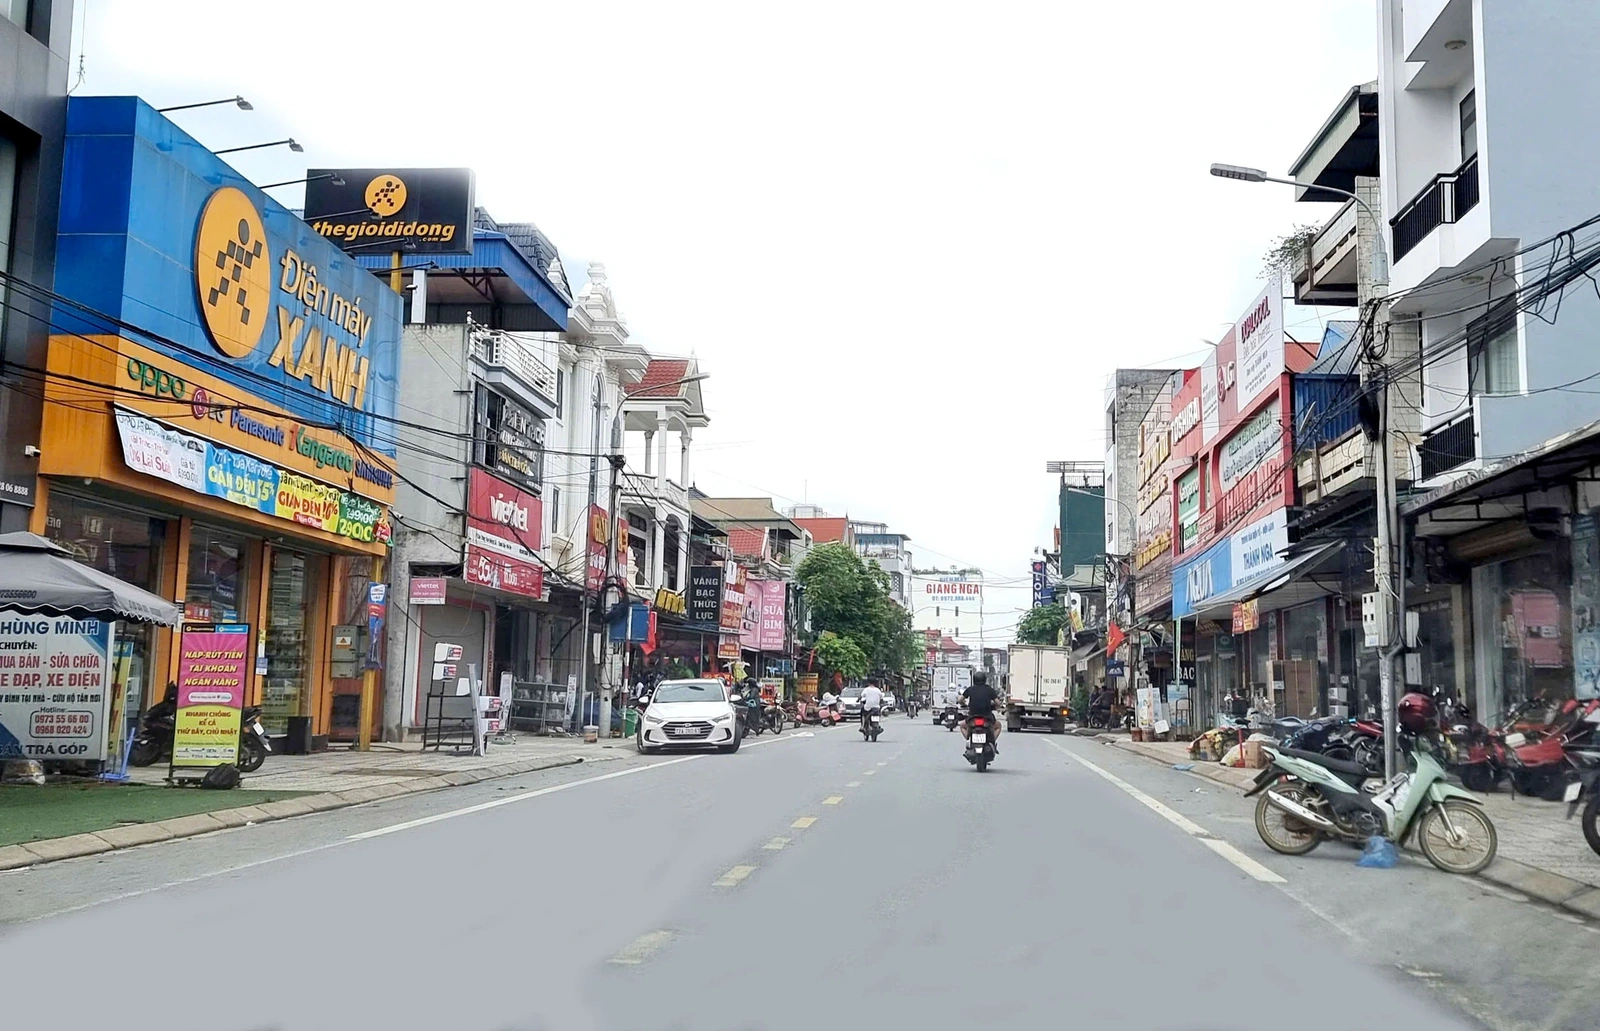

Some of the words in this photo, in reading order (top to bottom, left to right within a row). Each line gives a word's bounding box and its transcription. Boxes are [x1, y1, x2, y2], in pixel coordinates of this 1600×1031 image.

[312, 220, 455, 242] thegioididong
[280, 249, 329, 317] Điện
[329, 297, 372, 348] máy
[269, 306, 370, 410] XANH
[127, 358, 185, 399] oppo
[230, 408, 285, 447] Panasonic
[1170, 396, 1201, 446] TOSHIBA
[289, 423, 354, 473] Kangaroo
[1261, 542, 1274, 565] NGA
[693, 576, 719, 587] VÀNG
[926, 583, 957, 595] GIANG
[959, 583, 980, 595] NGA
[695, 589, 715, 600] BẠC
[693, 599, 717, 609] THỨC
[763, 602, 783, 616] SỮA
[695, 611, 714, 622] LỰC
[1, 617, 50, 635] HÙNG
[55, 620, 100, 636] MINH
[0, 641, 38, 650] CHUYÊN:
[19, 653, 40, 669] BÁN
[50, 651, 70, 669] SỬA
[73, 653, 100, 669] CHỮA
[13, 673, 42, 691] ĐẠP,
[47, 673, 64, 687] XE
[68, 670, 101, 689] ĐIỆN
[35, 715, 54, 725] 0973
[56, 715, 66, 725] 55
[58, 742, 88, 756] GÓP
